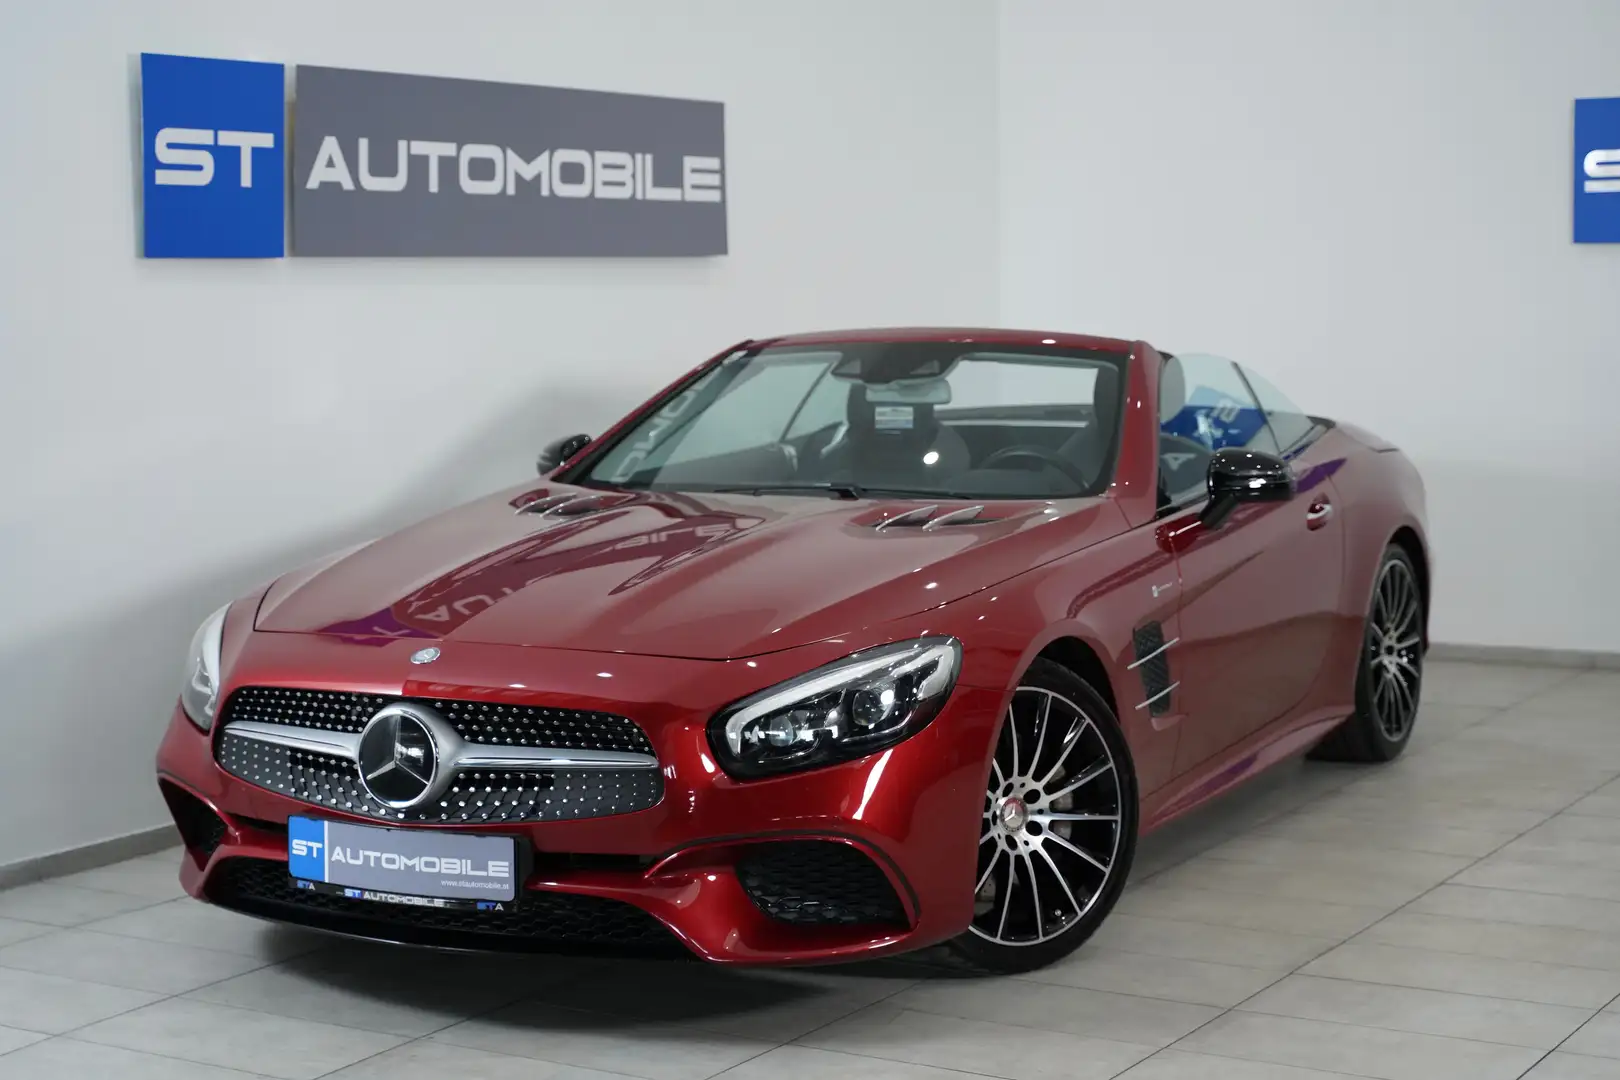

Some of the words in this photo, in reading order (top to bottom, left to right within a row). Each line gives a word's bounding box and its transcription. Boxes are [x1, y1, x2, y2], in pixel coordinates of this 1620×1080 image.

[154, 127, 275, 189] ST
[306, 135, 722, 203] AUTOMOBILE
[292, 839, 323, 858] ST
[331, 846, 509, 877] AUTOMOBILE
[344, 888, 361, 898] ST
[363, 891, 445, 907] AUTOMOBILE
